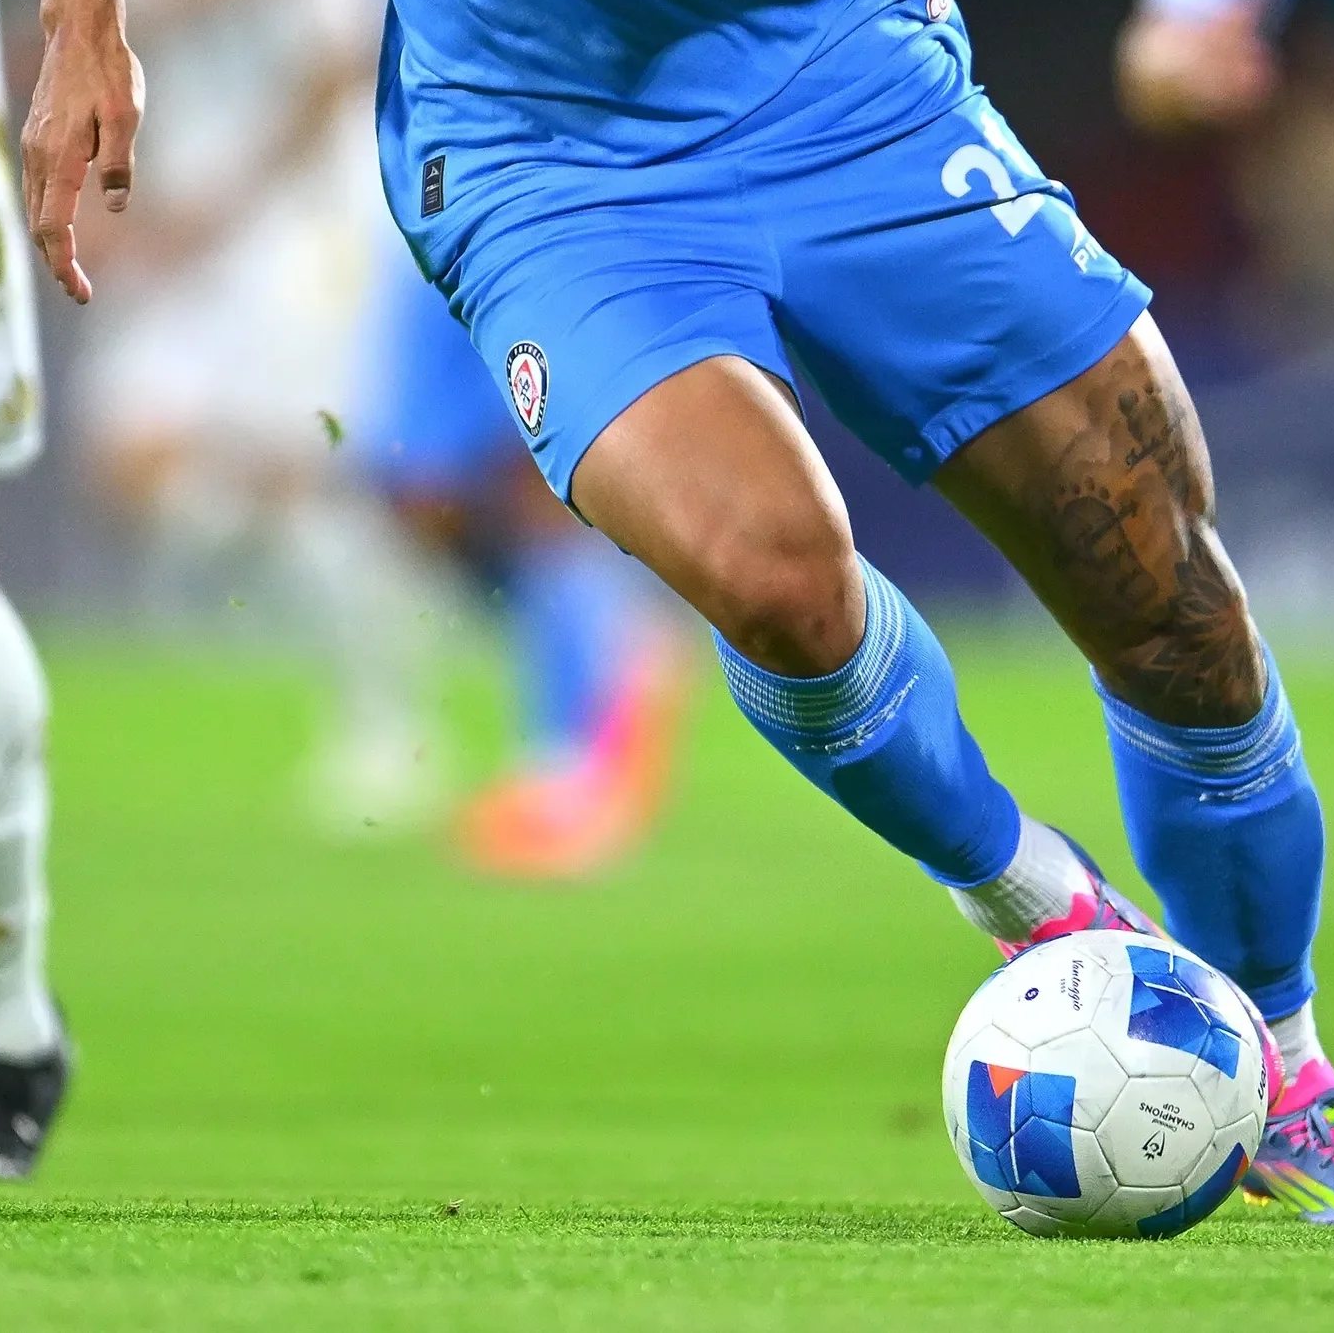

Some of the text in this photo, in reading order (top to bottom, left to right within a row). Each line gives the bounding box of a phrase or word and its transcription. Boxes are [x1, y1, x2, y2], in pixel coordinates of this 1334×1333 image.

[1068, 959, 1084, 1011] Vantaggio
[1139, 1102, 1195, 1131] CHAMPIONS
[1162, 1103, 1180, 1114] CUP
